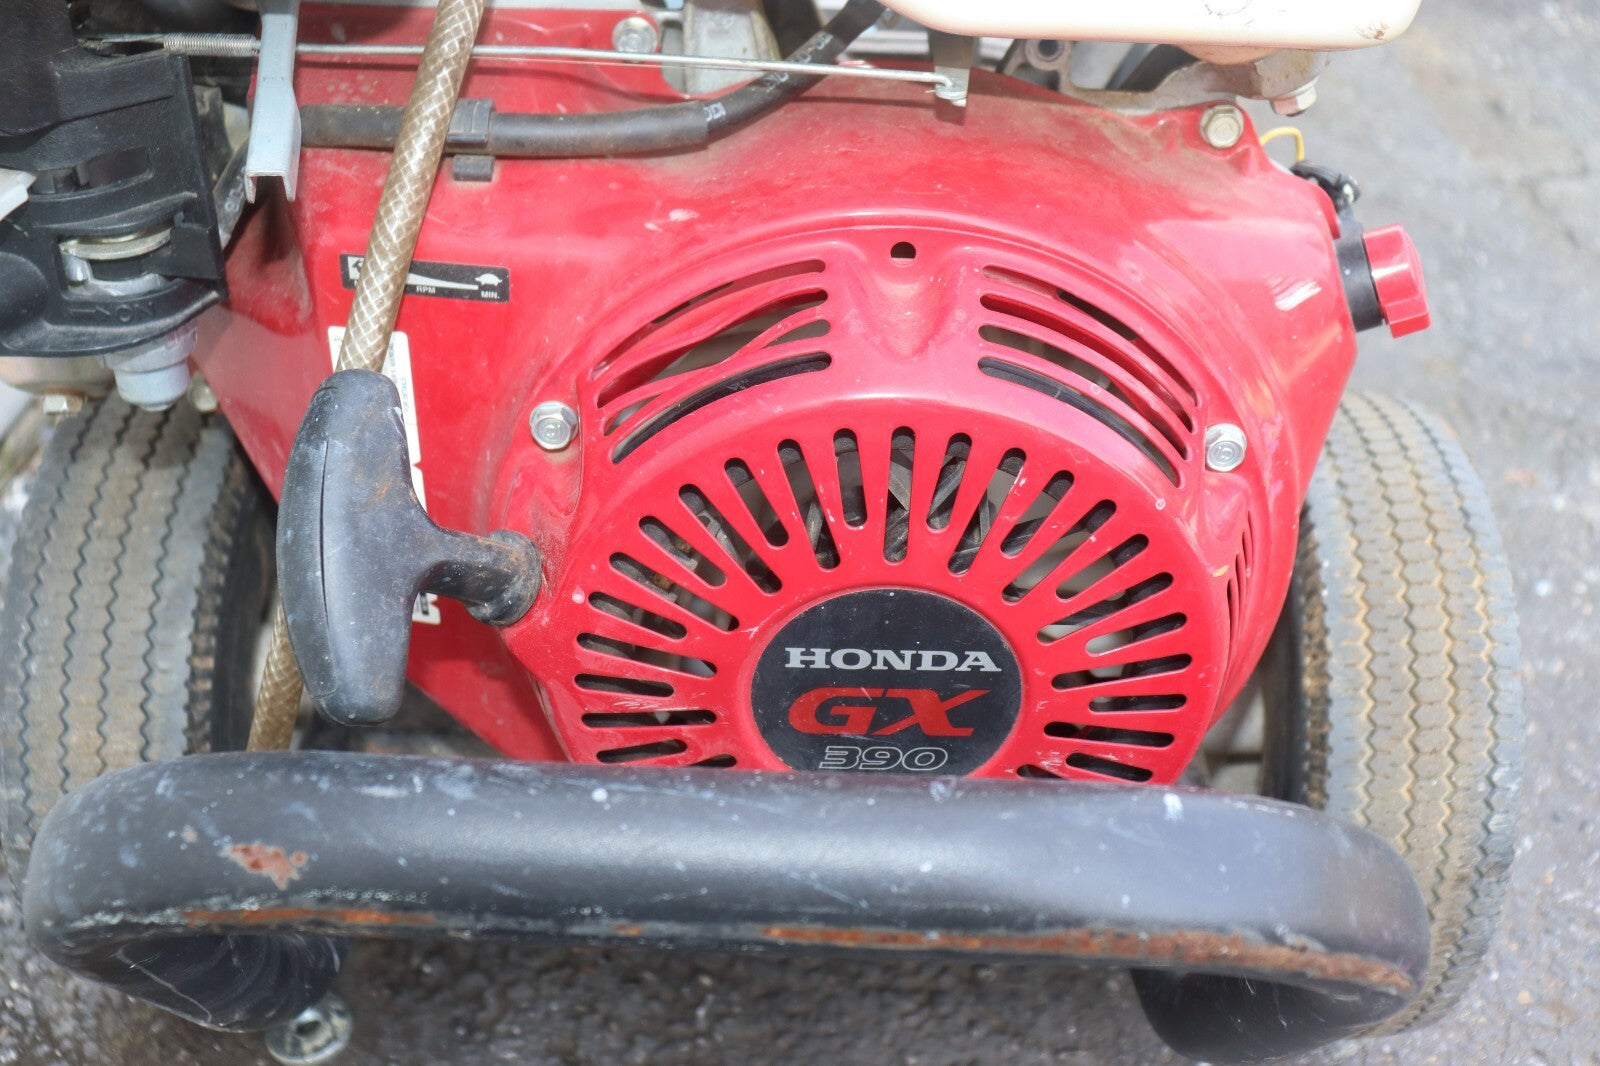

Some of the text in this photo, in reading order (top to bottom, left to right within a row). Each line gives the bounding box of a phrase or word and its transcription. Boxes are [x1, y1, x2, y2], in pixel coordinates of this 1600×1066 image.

[415, 285, 437, 295] RPM
[784, 647, 1002, 672] HONDA
[788, 686, 992, 737] GX
[818, 745, 949, 771] 390
